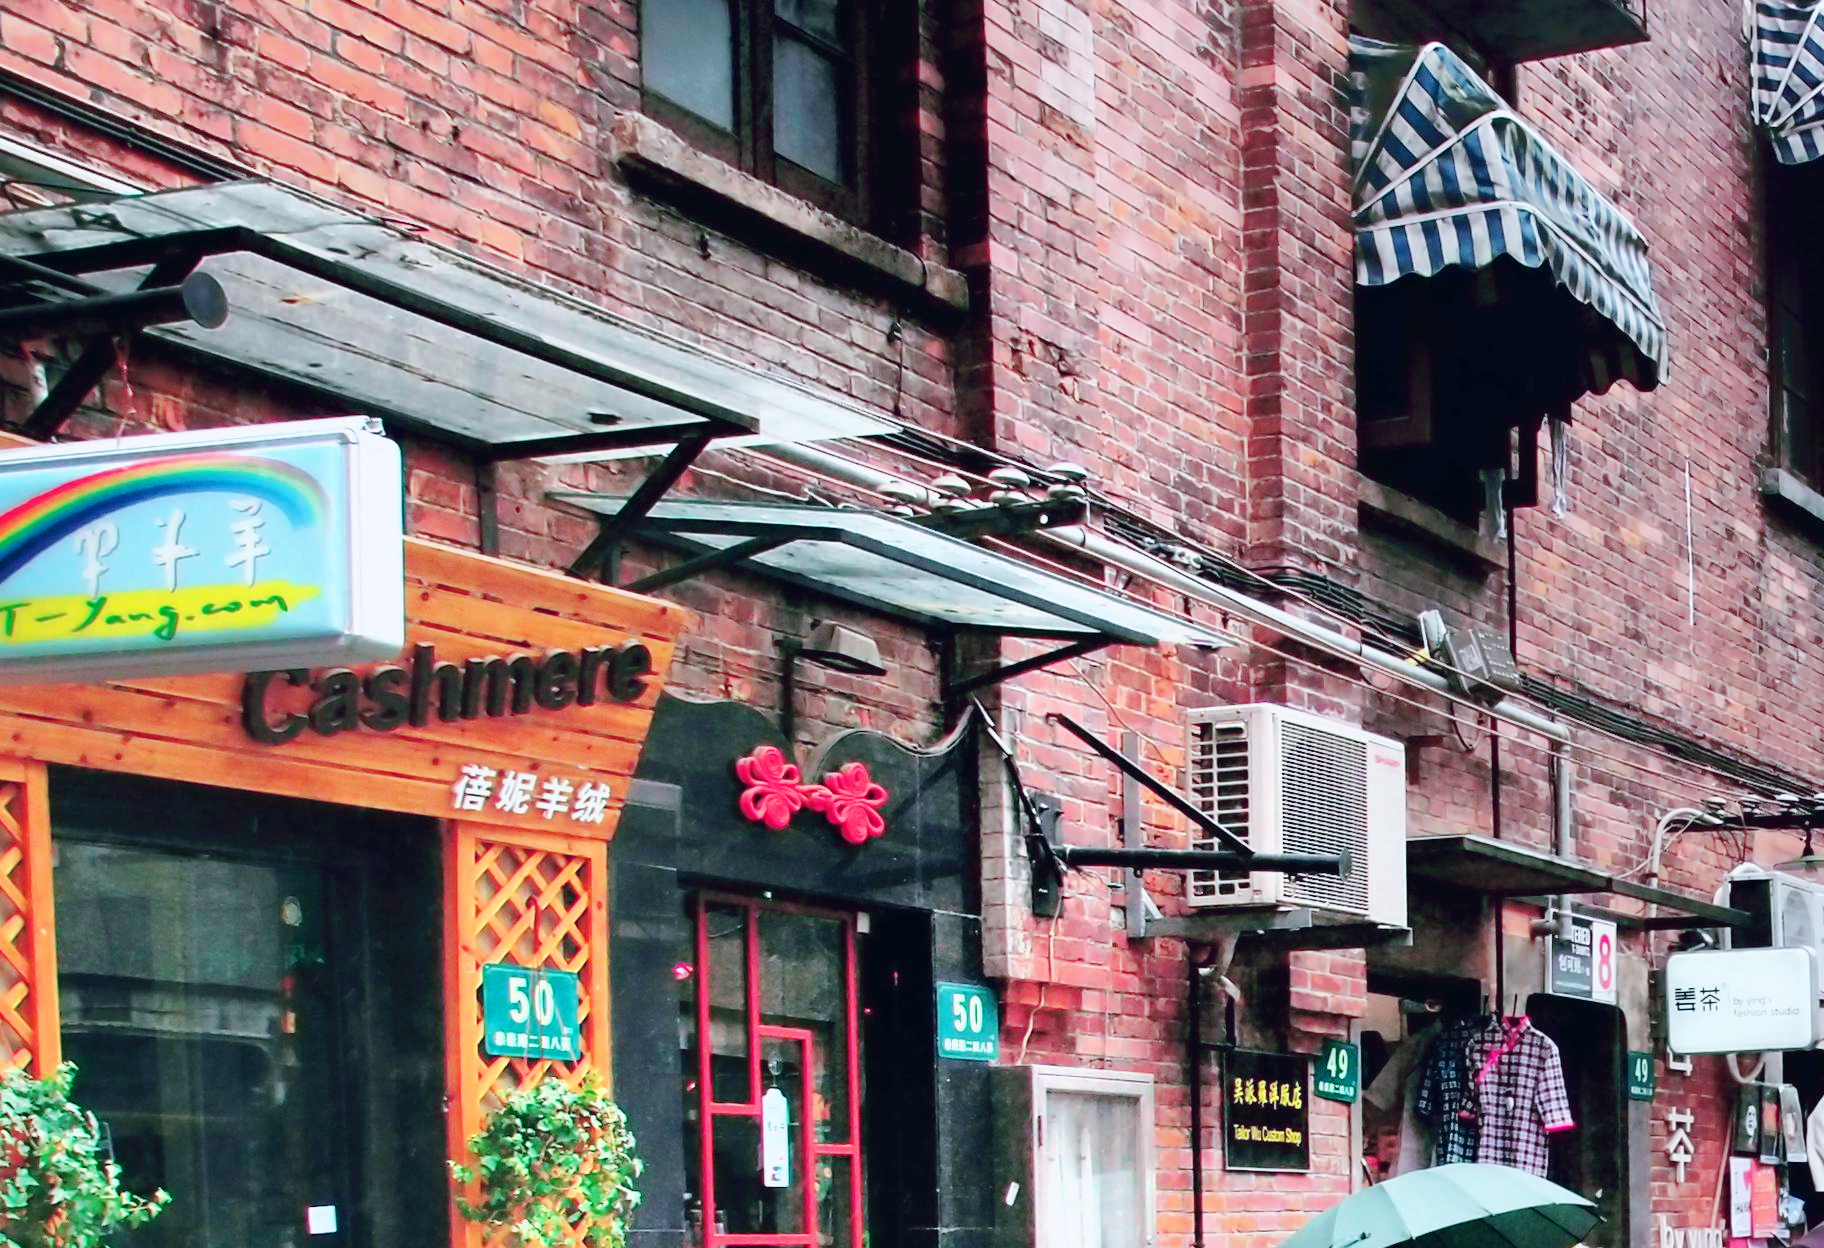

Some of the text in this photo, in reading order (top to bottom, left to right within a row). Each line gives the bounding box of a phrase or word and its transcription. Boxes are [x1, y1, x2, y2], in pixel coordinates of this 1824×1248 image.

[241, 638, 653, 745] Cashmere
[451, 764, 612, 825] 蓓妮羊绒
[1598, 934, 1612, 990] 8
[507, 976, 555, 1027] 50
[953, 993, 983, 1034] 50
[1733, 997, 1745, 1007] by
[1733, 1007, 1800, 1018] fashion studio
[1326, 1046, 1349, 1080] 49
[1634, 1057, 1649, 1083] 49
[1233, 1124, 1250, 1141] Tailor
[1285, 1127, 1302, 1147] Shop
